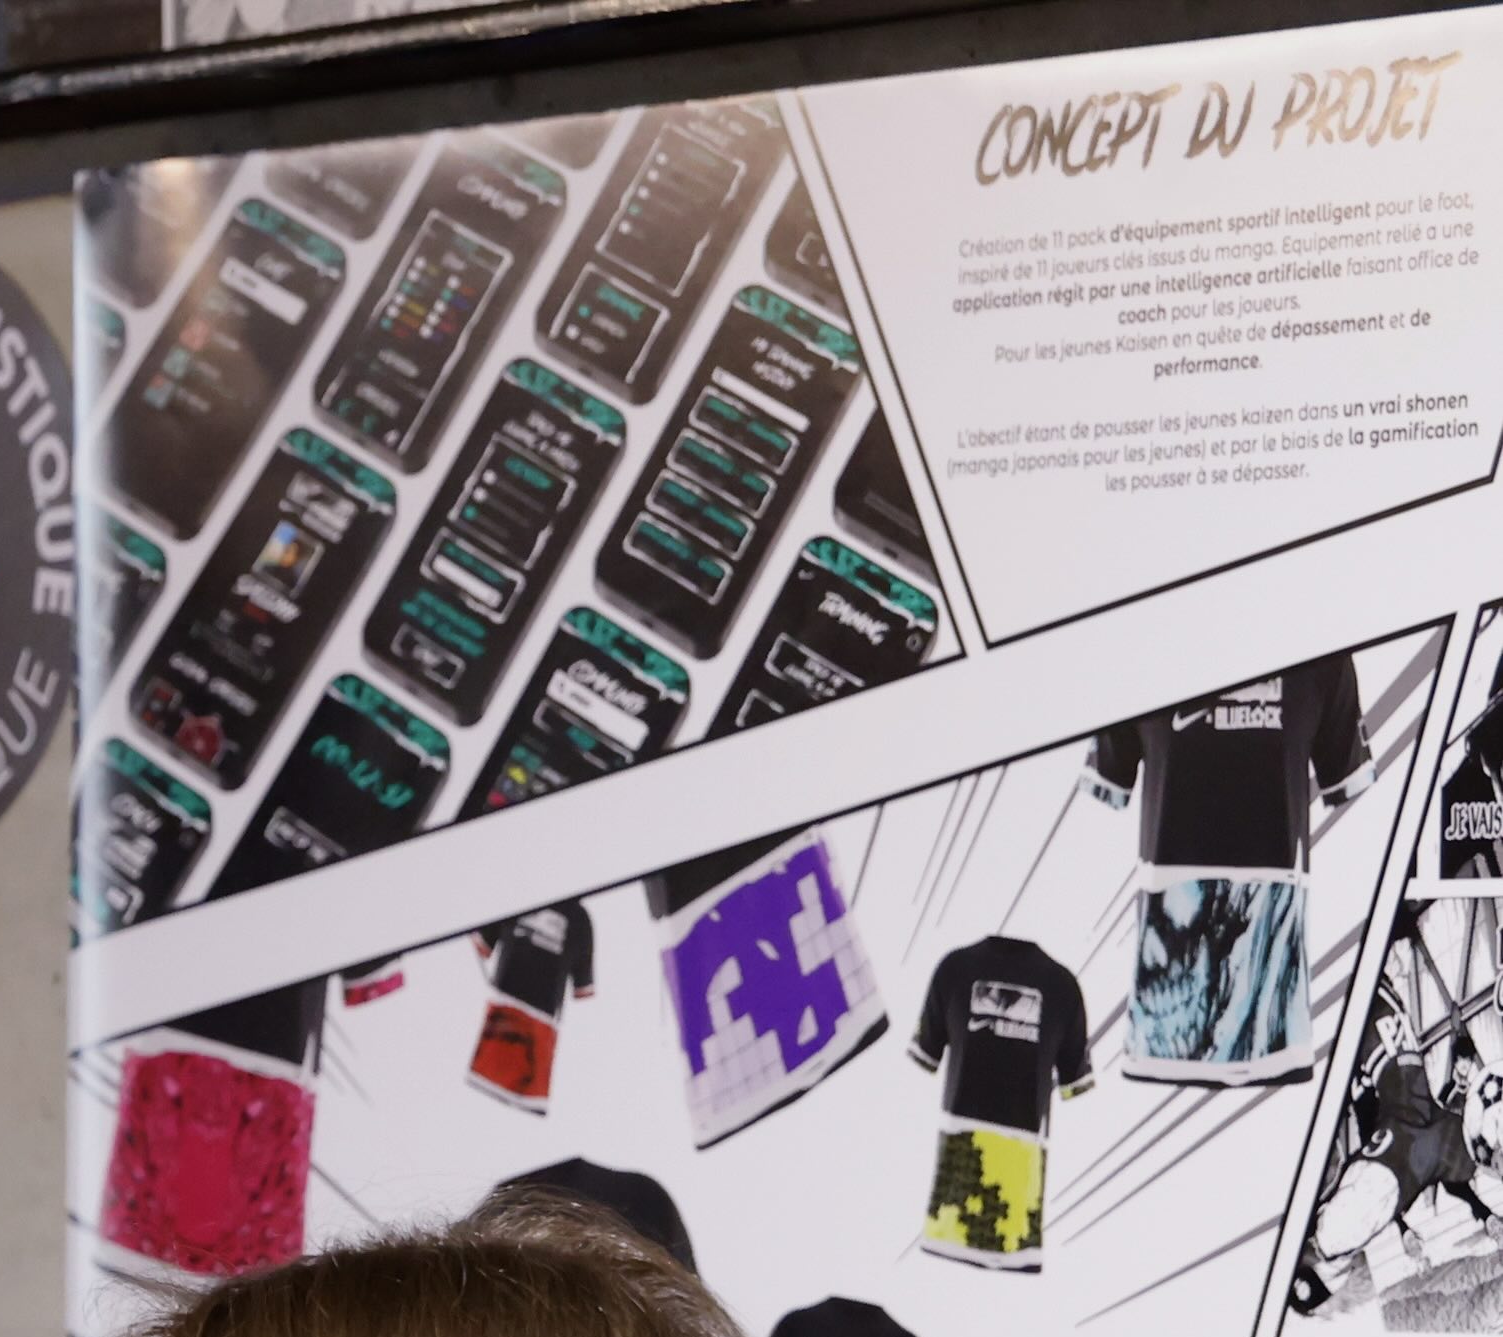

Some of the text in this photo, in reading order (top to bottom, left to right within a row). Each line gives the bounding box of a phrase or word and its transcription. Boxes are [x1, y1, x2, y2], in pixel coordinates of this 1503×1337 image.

[974, 50, 1464, 186] CONCEPT DU PROJET
[958, 236, 1024, 259] Création
[1029, 233, 1048, 252] de
[1067, 228, 1106, 250] pack
[1110, 215, 1222, 245] d'équipement
[1228, 208, 1281, 235] sportif
[1285, 201, 1371, 225] intelligent
[1375, 199, 1414, 219] pour
[1419, 196, 1433, 213] le
[1438, 191, 1474, 211] foot,
[952, 248, 1479, 315] application régit par une intelligence artificielle faisant office de
[958, 263, 1009, 287] inspiré
[1013, 261, 1033, 281] de
[1050, 254, 1110, 281] joueurs
[1114, 252, 1144, 271] clés
[1147, 246, 1186, 267] issus
[1189, 243, 1211, 262] du
[1386, 223, 1421, 245] relié
[1441, 221, 1474, 239] une
[995, 308, 1431, 363] Pour les jeunes Kaisen en quête de dépassement et de
[1118, 294, 1301, 325] coach pour les joueurs.
[1154, 353, 1262, 381] performance.
[1025, 424, 1066, 444] étant
[1070, 421, 1090, 440] de
[1093, 418, 1155, 441] pousser
[1159, 414, 1181, 433] les
[1183, 411, 1237, 435] jeunes
[1241, 406, 1293, 427] kaizen
[1298, 402, 1338, 422] dans
[1343, 402, 1364, 418] un
[1369, 394, 1401, 416] vrai
[1406, 392, 1469, 414] shonen
[947, 419, 1479, 479] (manga japonais pour les jeunes) et par le biais de la gamification
[1106, 462, 1310, 494] les pousser à se dépasser.
